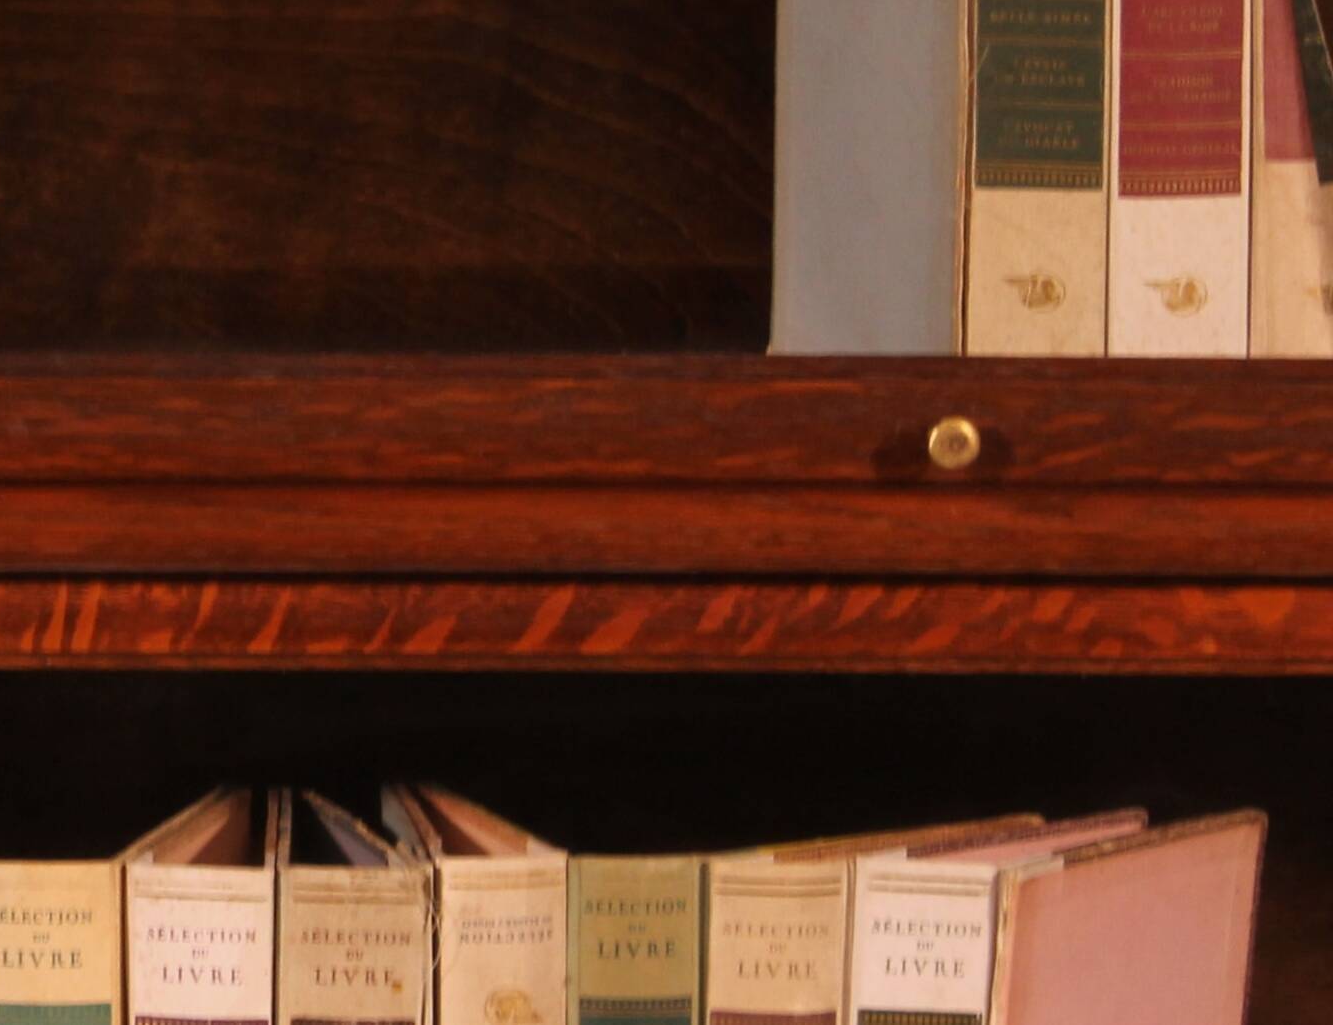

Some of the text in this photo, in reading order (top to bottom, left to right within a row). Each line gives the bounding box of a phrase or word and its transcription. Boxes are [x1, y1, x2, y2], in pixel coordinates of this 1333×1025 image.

[2, 948, 84, 969] LIVRE
[598, 940, 676, 960] LIVRE
[162, 966, 243, 986] LIVRE
[737, 960, 818, 979] LIVRE
[885, 958, 966, 978] LIVRE
